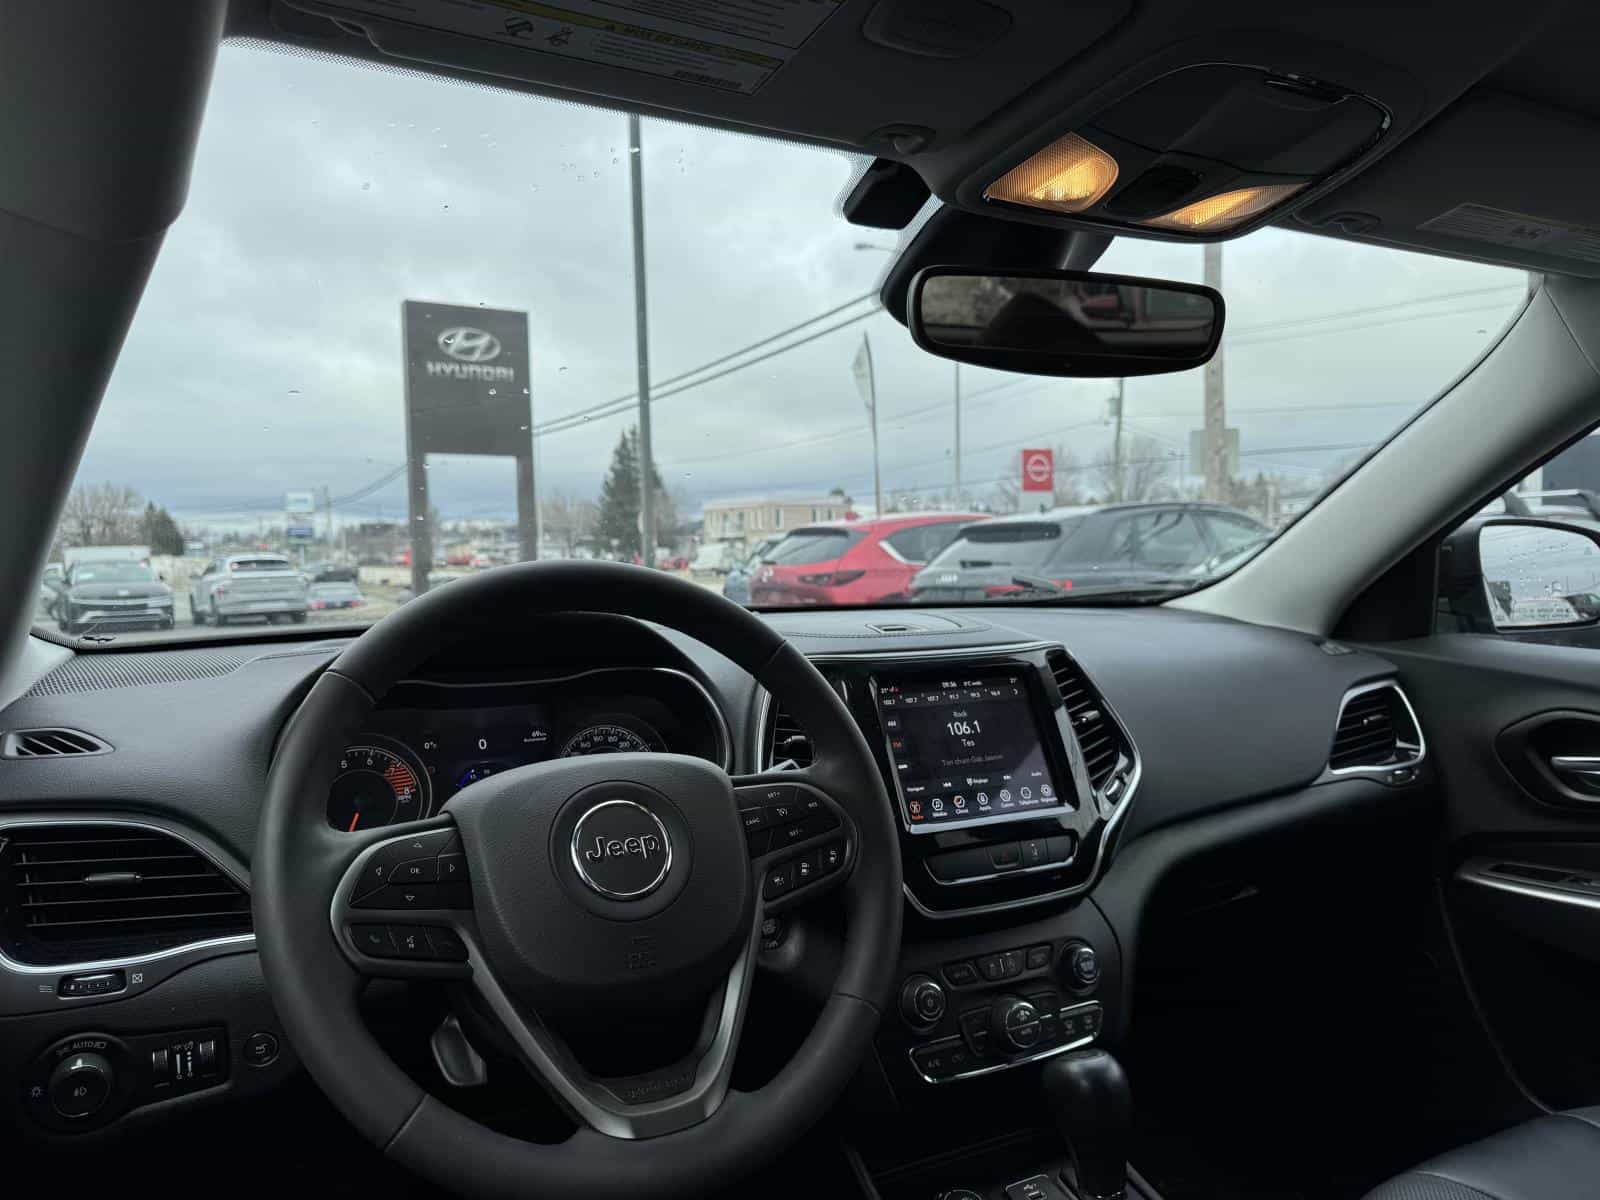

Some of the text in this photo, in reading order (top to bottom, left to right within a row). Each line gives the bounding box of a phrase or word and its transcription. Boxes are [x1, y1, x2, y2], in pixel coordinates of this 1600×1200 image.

[426, 361, 514, 383] HYUNDAI
[947, 720, 981, 736] 106.1
[586, 835, 660, 861] Jeep
